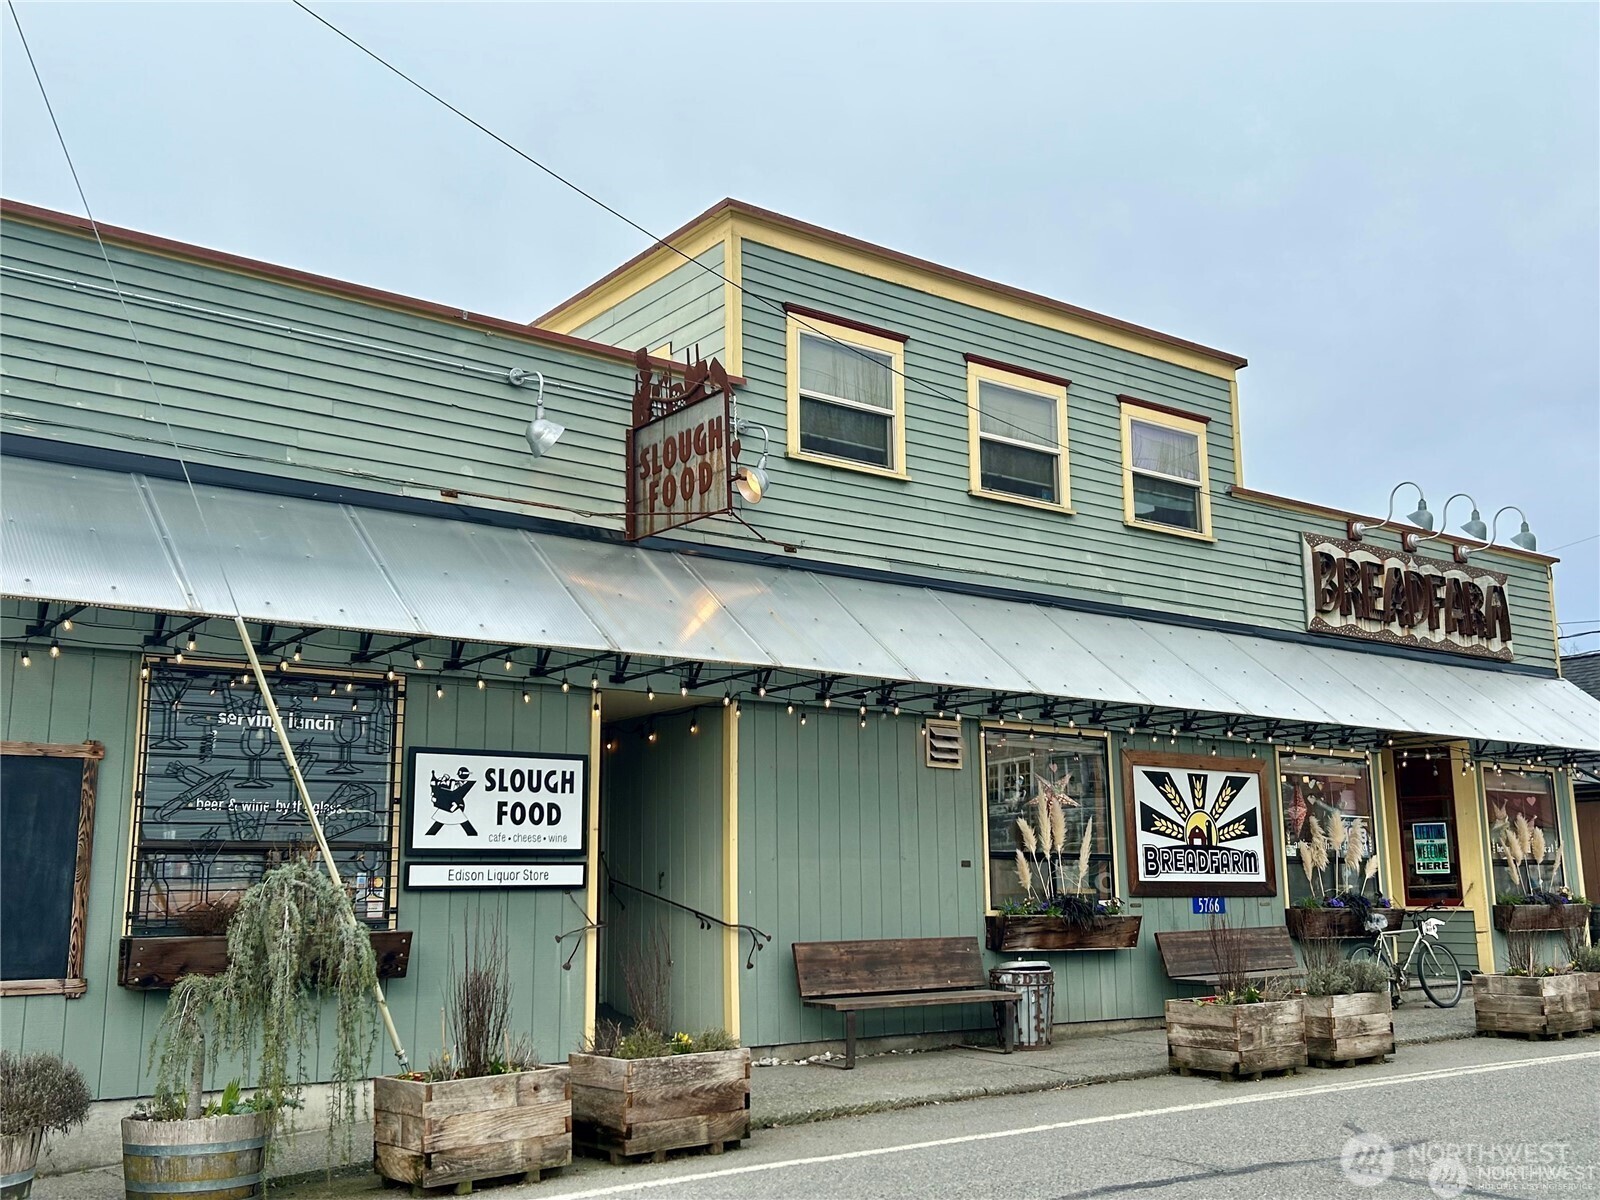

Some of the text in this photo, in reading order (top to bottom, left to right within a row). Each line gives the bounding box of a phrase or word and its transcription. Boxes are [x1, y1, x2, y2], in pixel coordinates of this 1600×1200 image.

[639, 415, 723, 480] SLOUGH
[649, 461, 713, 513] FOOD
[1312, 550, 1512, 642] BREADFARM
[288, 712, 335, 731] lunch
[484, 767, 575, 794] SLOUGH
[196, 798, 223, 811] beer
[242, 799, 270, 813] wine
[275, 799, 291, 815] by
[496, 800, 562, 826] FOOD
[488, 832, 568, 844] cafe cheese wine
[1142, 844, 1260, 878] BREADFARM
[1416, 862, 1449, 870] HERE
[447, 868, 549, 883] Edison Liquor Store
[1198, 897, 1220, 913] 5766
